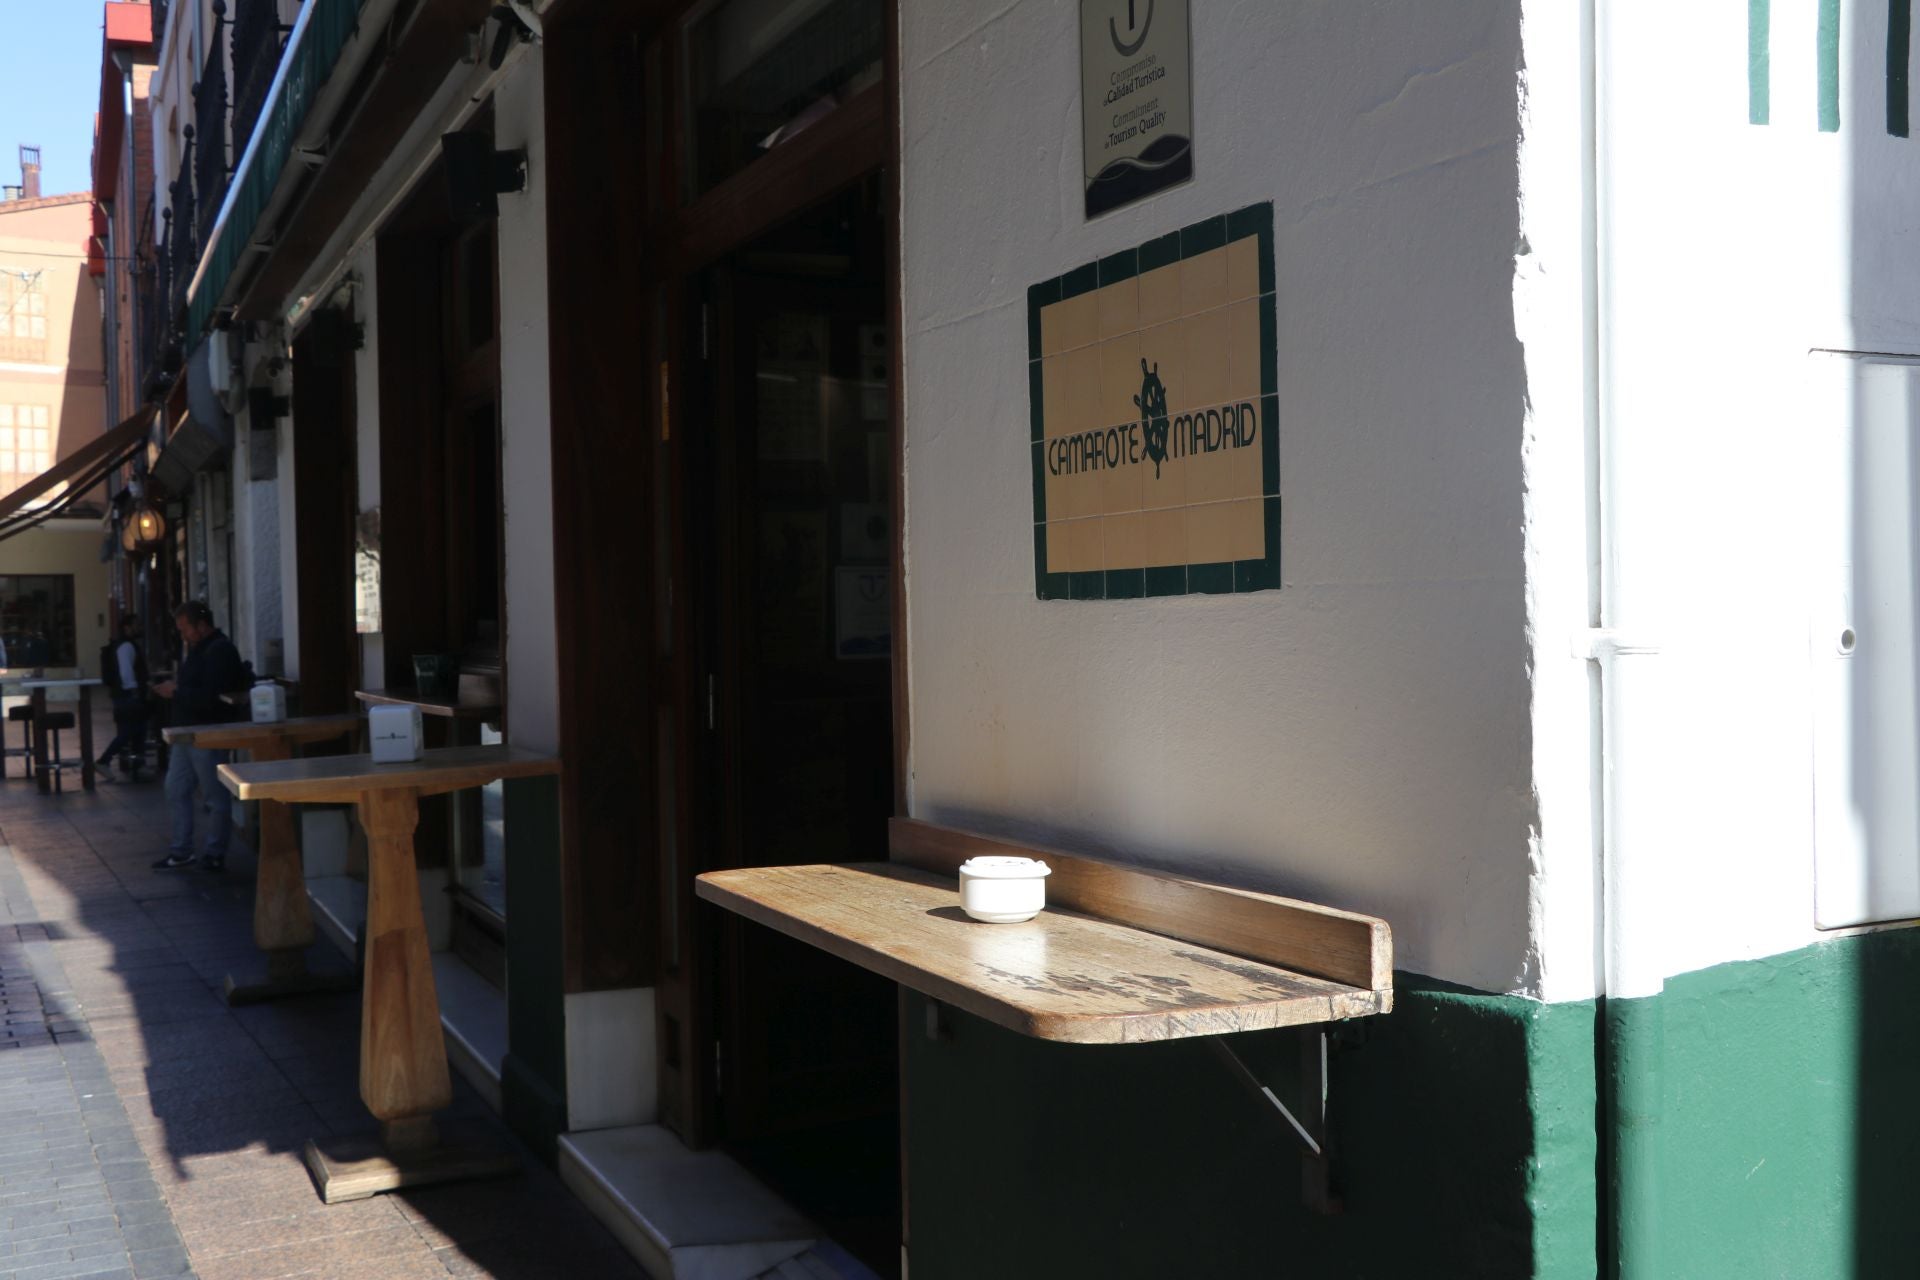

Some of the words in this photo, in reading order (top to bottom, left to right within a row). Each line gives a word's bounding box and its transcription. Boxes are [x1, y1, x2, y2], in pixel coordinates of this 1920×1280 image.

[1111, 55, 1156, 85] Compromiso
[1107, 79, 1134, 103] Calidad
[1112, 98, 1159, 128] Commitment
[1109, 126, 1138, 147] Tourism
[1139, 112, 1167, 134] Quality
[1049, 424, 1138, 476] CAMAROTE
[1173, 402, 1256, 458] MADRID
